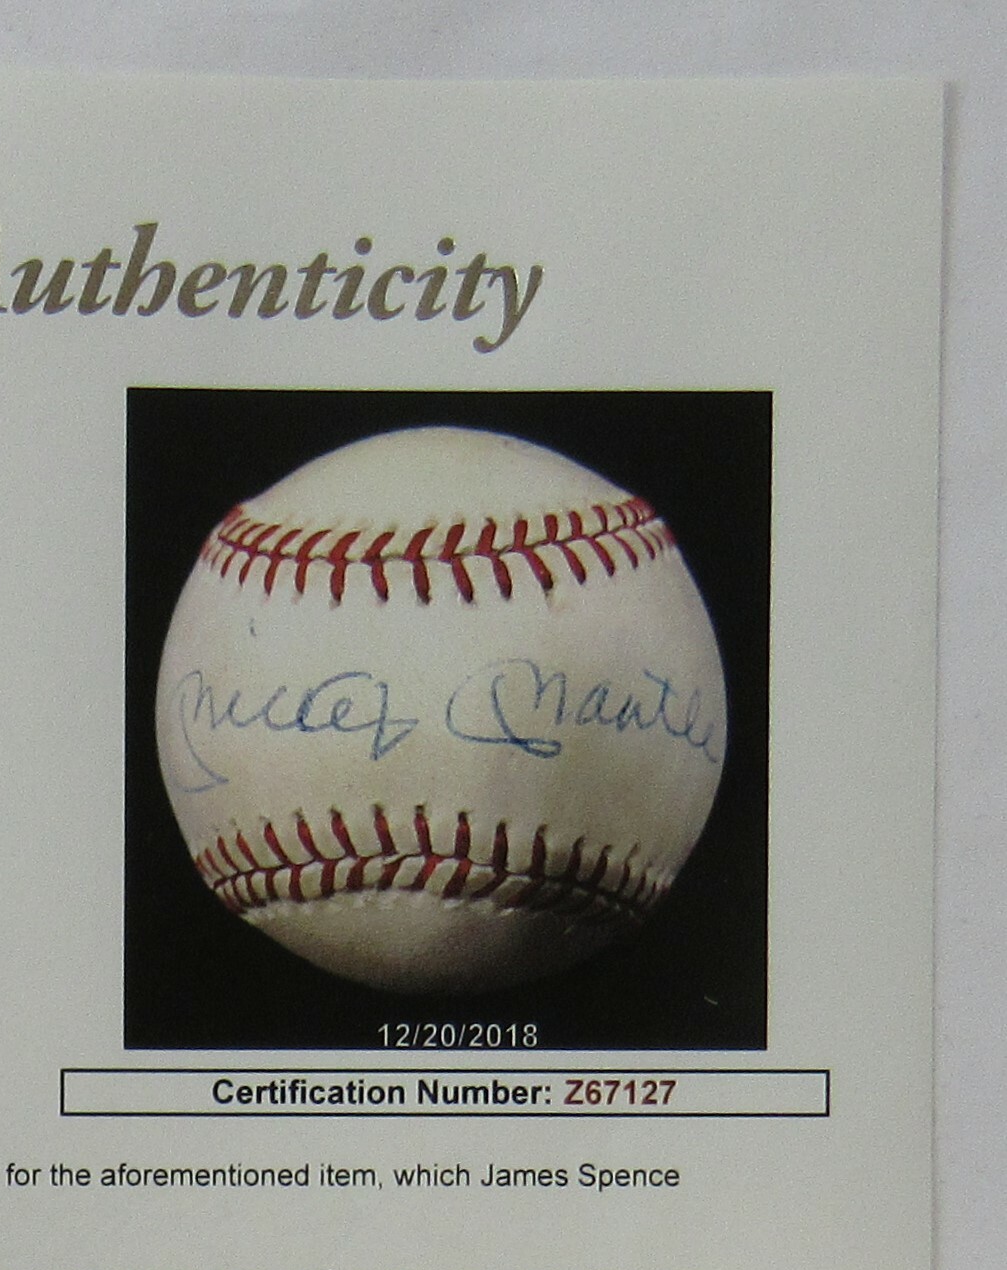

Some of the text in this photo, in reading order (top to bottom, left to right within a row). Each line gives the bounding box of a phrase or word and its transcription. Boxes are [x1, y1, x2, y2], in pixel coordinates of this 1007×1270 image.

[377, 1022, 539, 1048] 12/20/2018
[212, 1078, 676, 1105] Certification Number: Z67127
